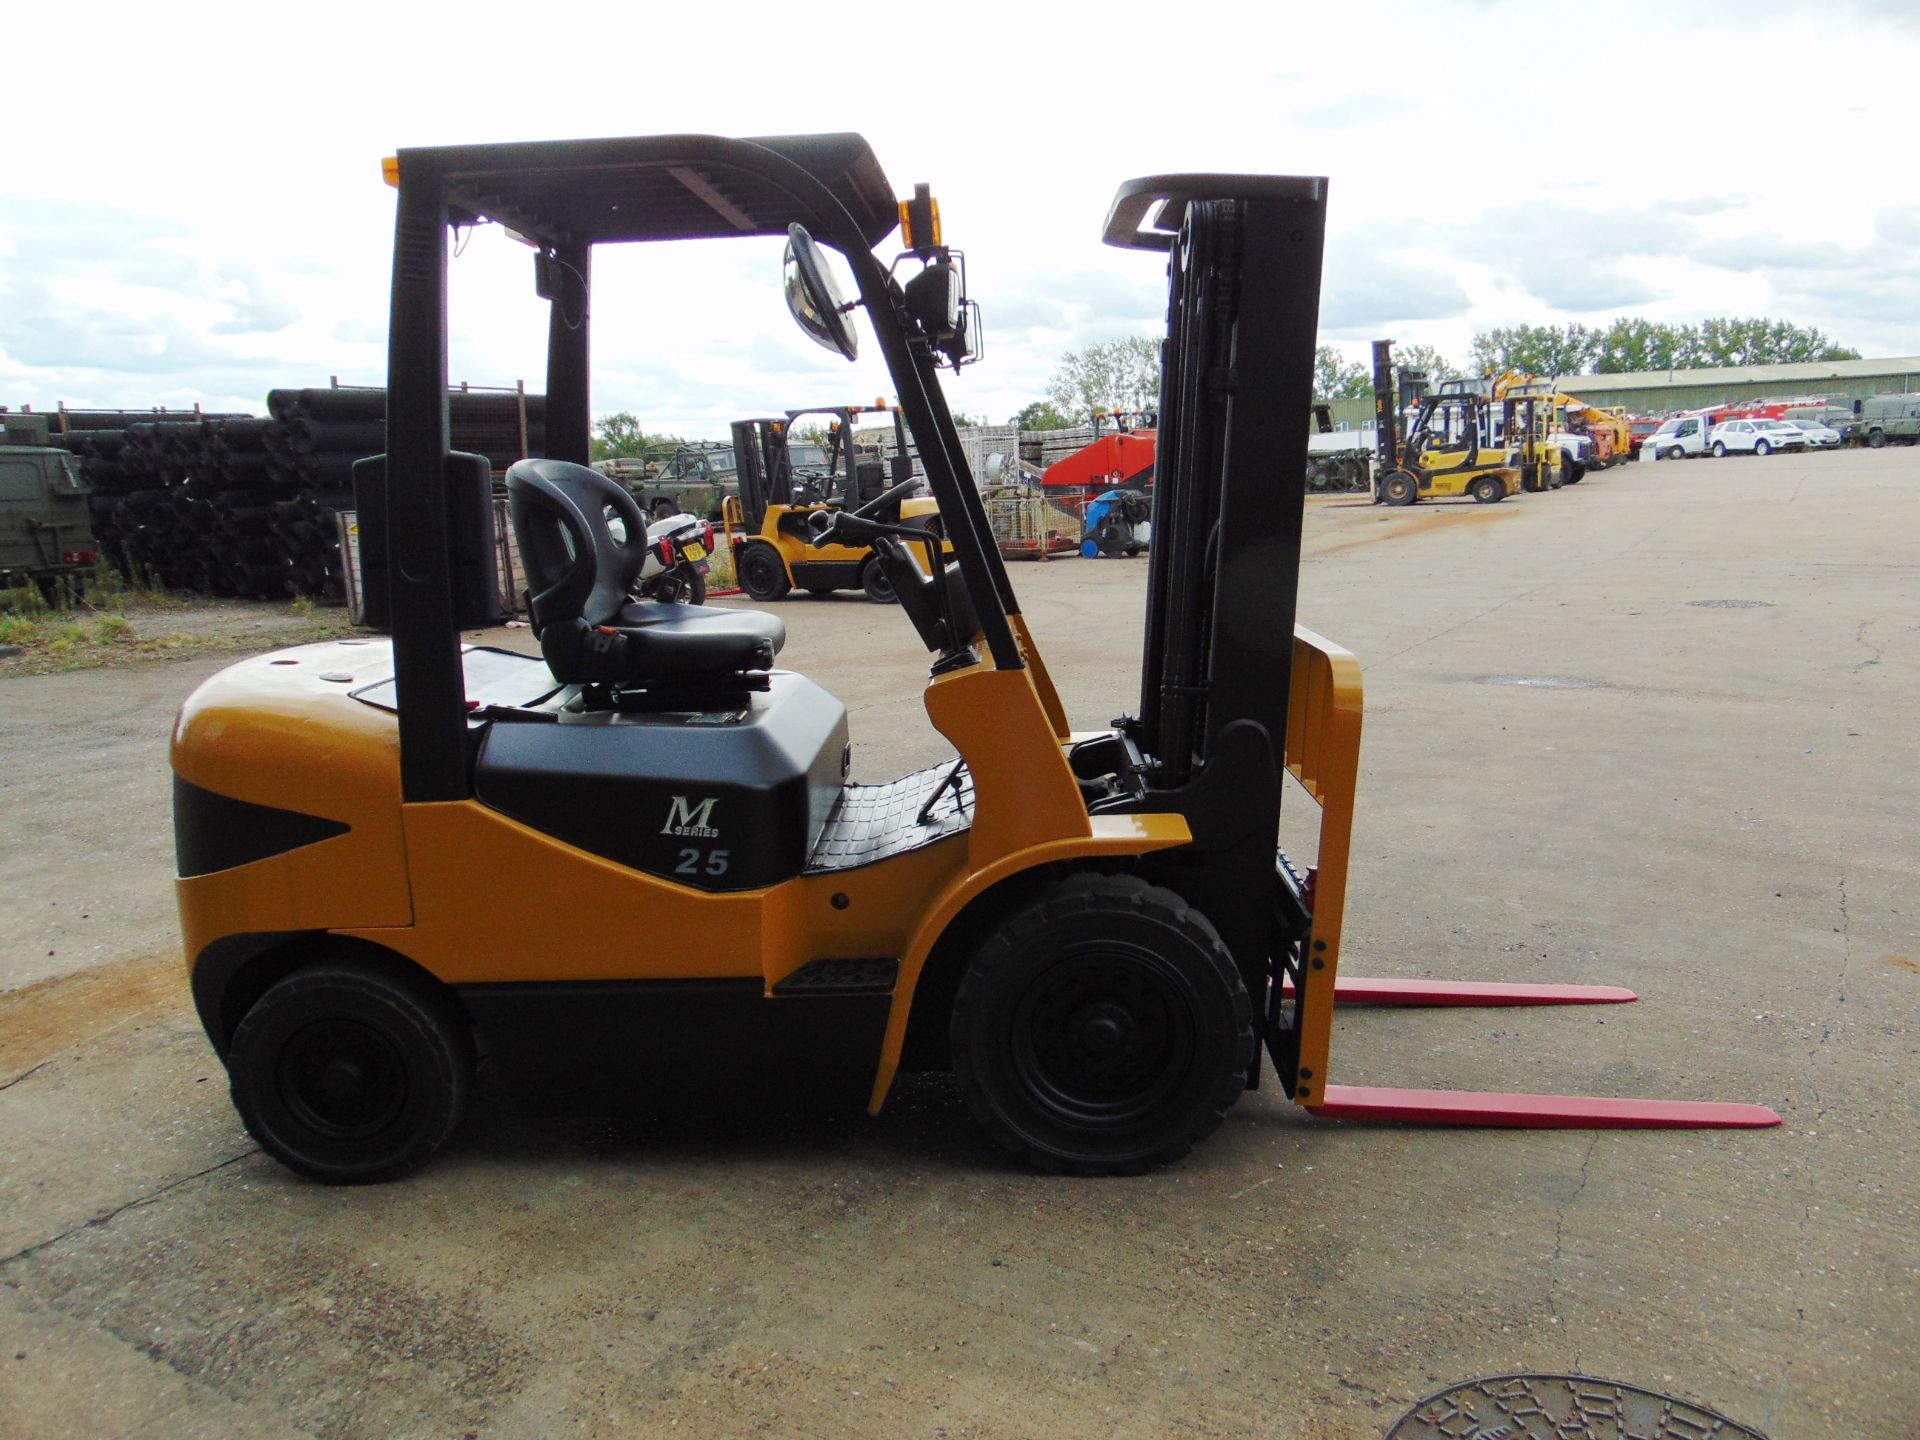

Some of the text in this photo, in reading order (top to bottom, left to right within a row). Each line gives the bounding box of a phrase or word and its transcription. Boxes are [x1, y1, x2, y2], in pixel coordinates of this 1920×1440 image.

[659, 796, 719, 834] M
[674, 826, 719, 838] SERIES
[675, 848, 730, 875] 25
